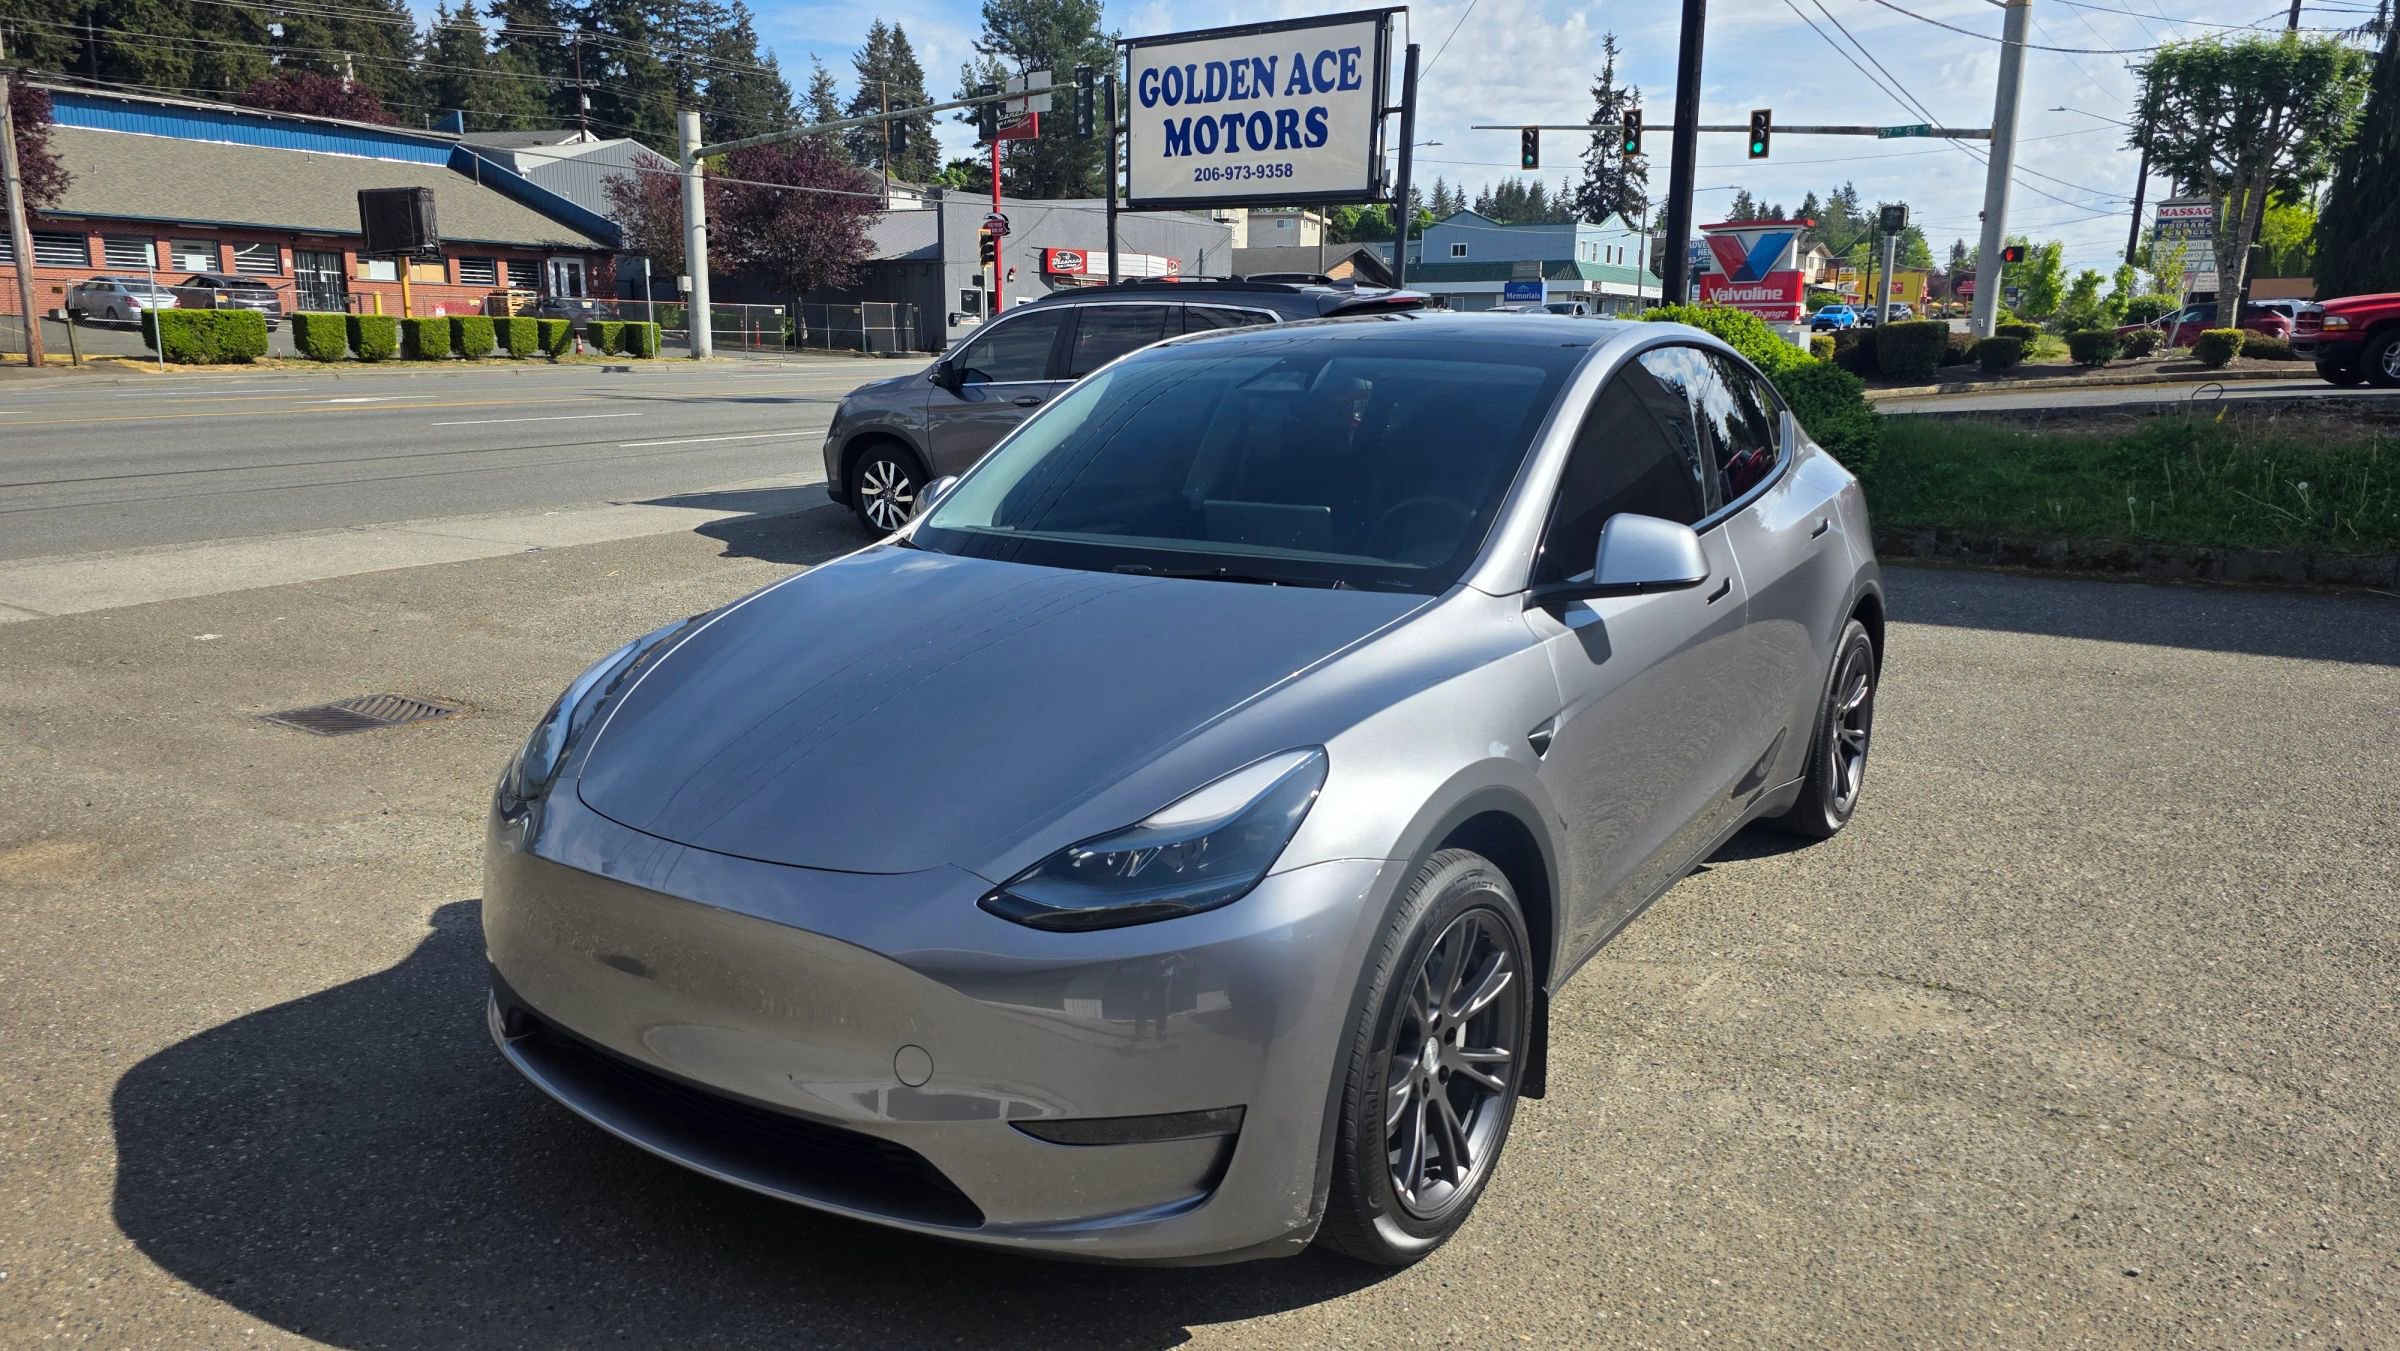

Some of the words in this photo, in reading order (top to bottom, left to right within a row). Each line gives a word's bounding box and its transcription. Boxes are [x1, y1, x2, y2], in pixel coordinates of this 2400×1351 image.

[1138, 55, 1278, 108] GOLDEN
[1284, 46, 1362, 97] ACE
[1163, 106, 1329, 158] MOTORS
[1880, 128, 1892, 138] 57
[1905, 126, 1918, 136] ST
[1194, 163, 1293, 182] 206-973-9358
[2159, 207, 2214, 217] MASSAG
[1506, 290, 1541, 300] Memorials
[1709, 286, 1783, 301] Valvoline
